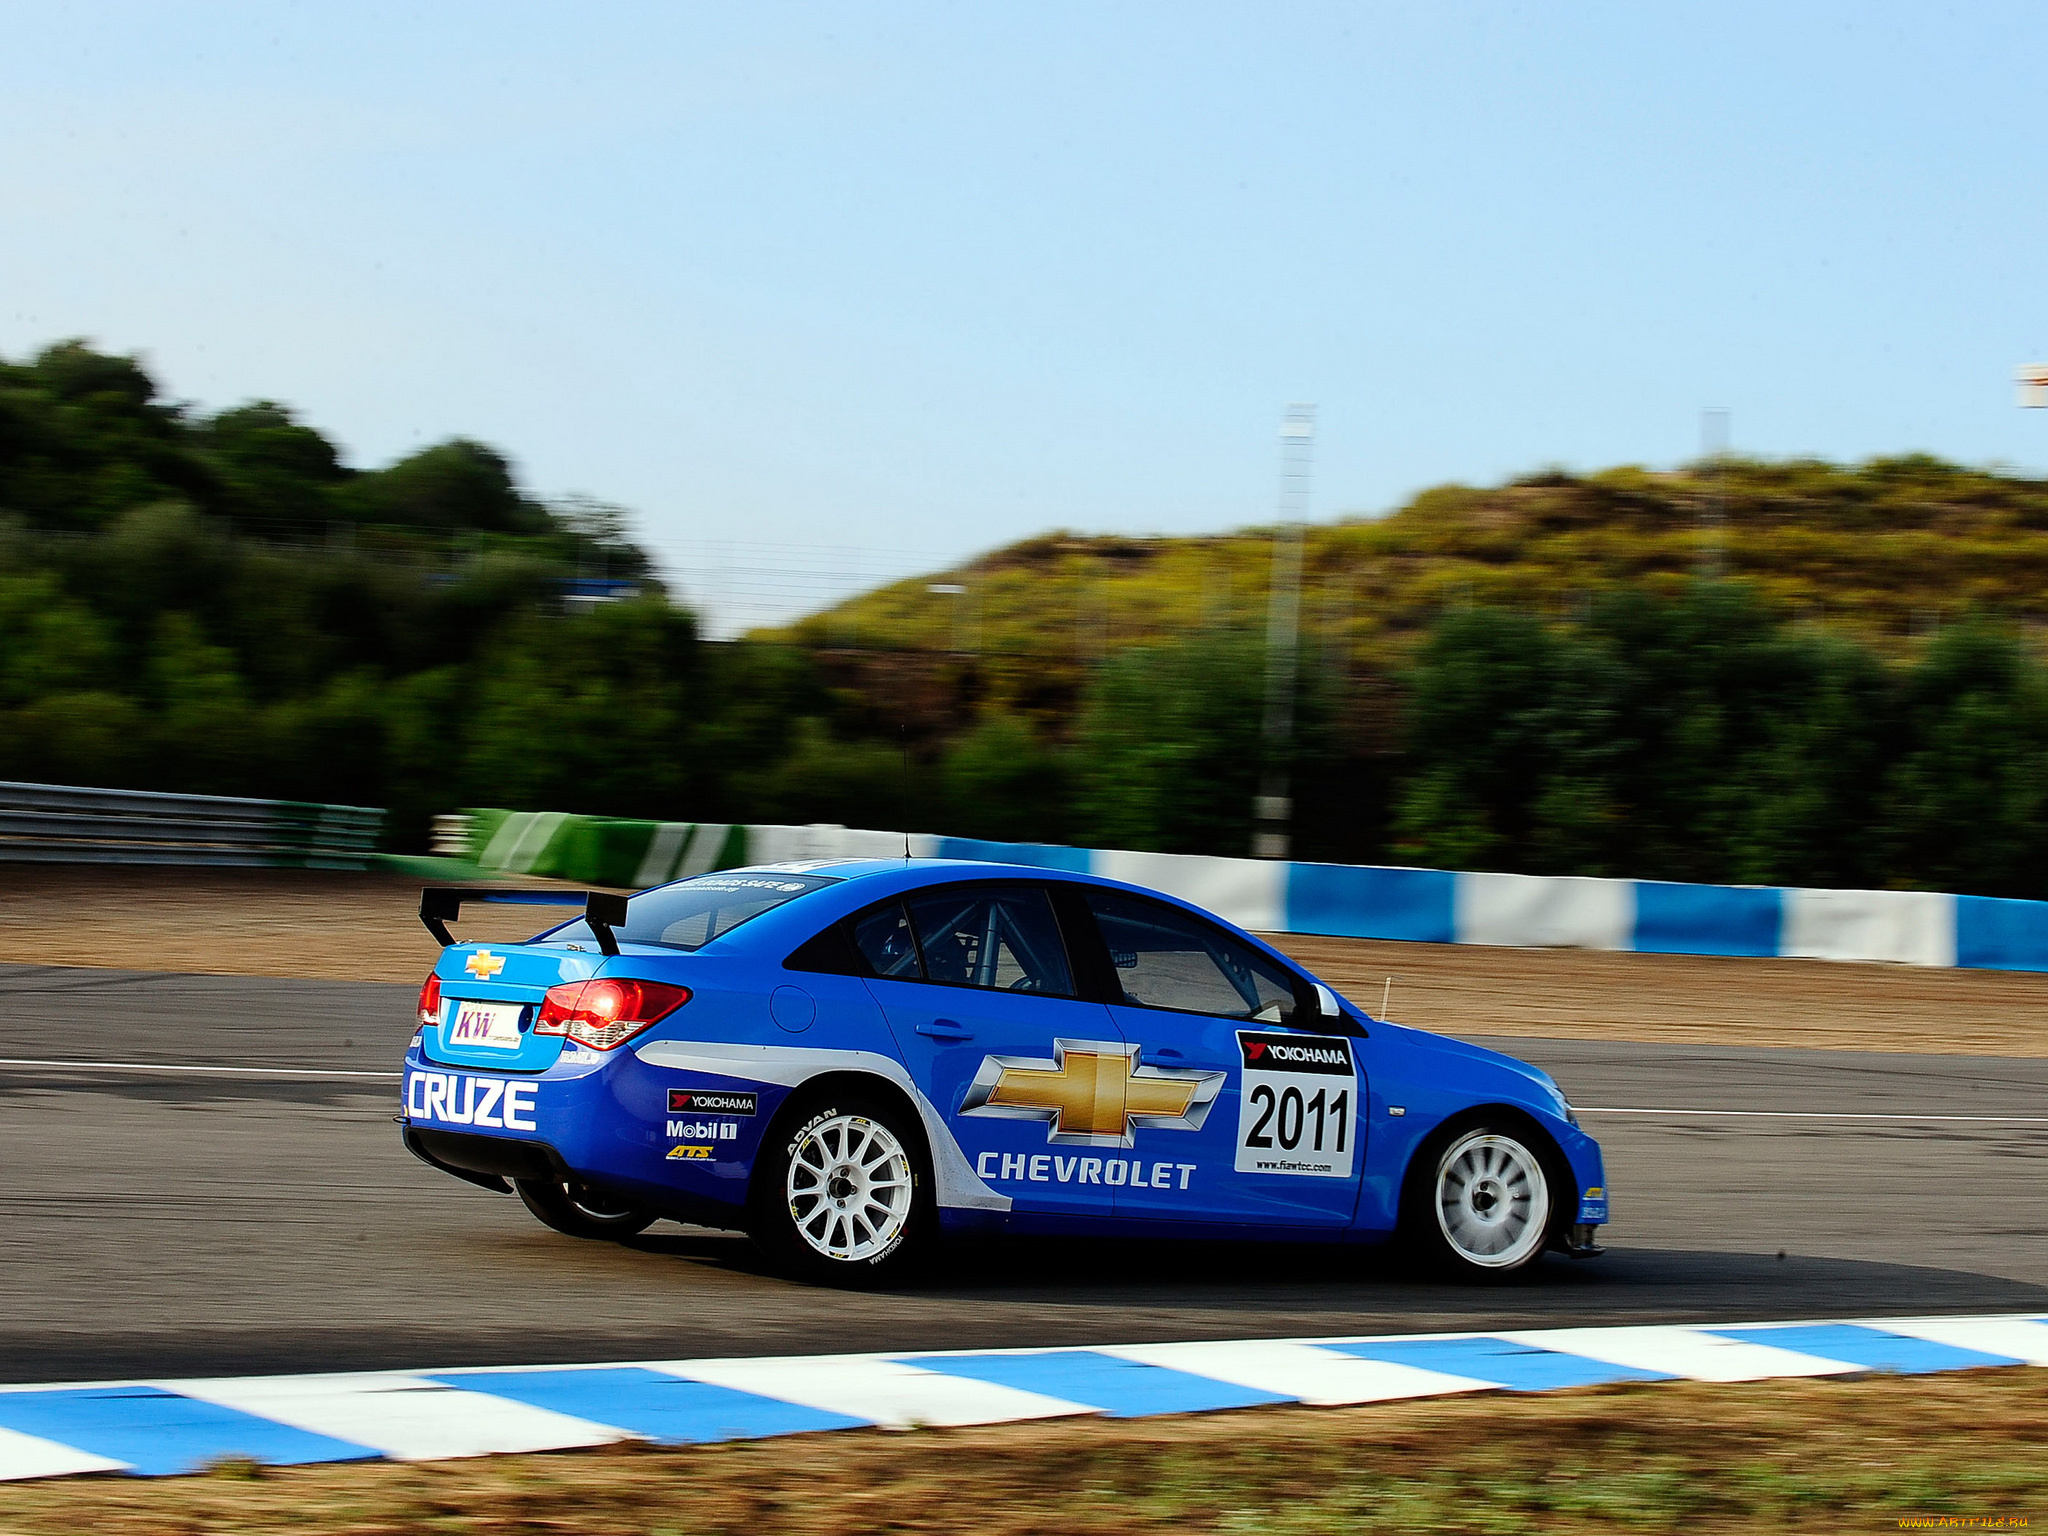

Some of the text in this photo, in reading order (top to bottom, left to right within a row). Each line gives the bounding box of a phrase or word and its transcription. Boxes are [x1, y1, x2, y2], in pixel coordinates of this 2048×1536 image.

[456, 1011, 496, 1038] KW
[1267, 1045, 1348, 1065] YOKOHAMA
[408, 1071, 539, 1132] CRUZE
[692, 1096, 754, 1110] YOKOHAMA
[666, 1120, 717, 1139] Mobil
[787, 1107, 838, 1157] ADVAN
[1245, 1084, 1348, 1153] 2011
[667, 1145, 714, 1158] ATS
[976, 1151, 1197, 1190] CHEVROLET
[868, 1234, 905, 1265] YOKOHAMA
